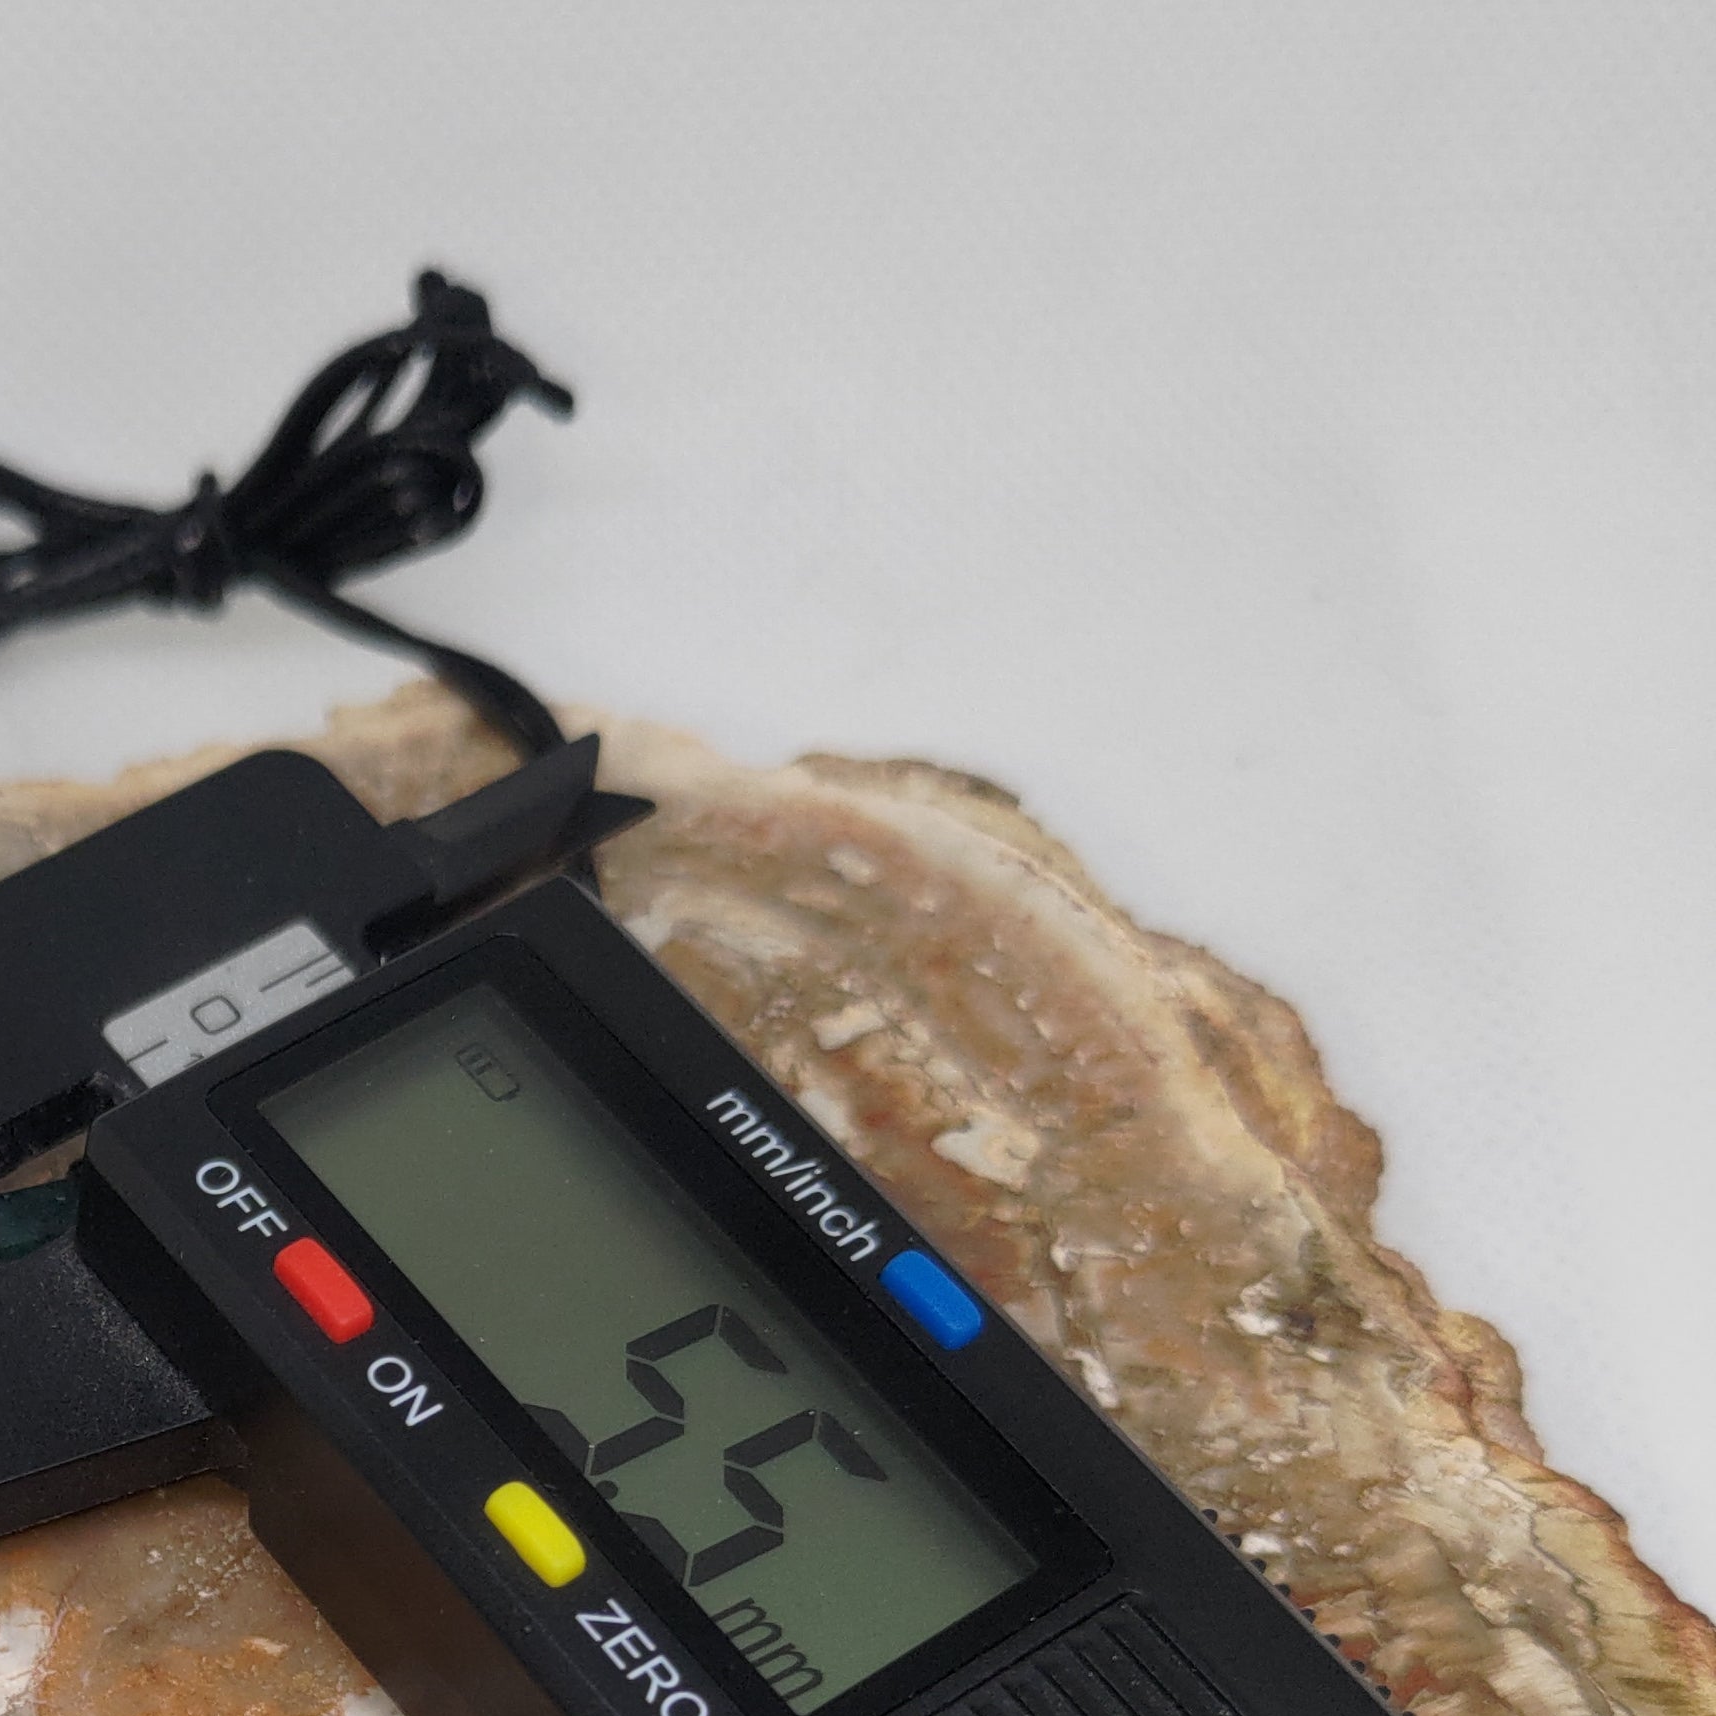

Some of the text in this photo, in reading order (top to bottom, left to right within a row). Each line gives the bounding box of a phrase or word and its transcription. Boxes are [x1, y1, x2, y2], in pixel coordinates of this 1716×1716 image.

[190, 994, 242, 1035] 0
[194, 1158, 290, 1239] OFF
[705, 1088, 882, 1263] mm/inch
[366, 1354, 445, 1428] ON
[711, 1597, 824, 1701] mm
